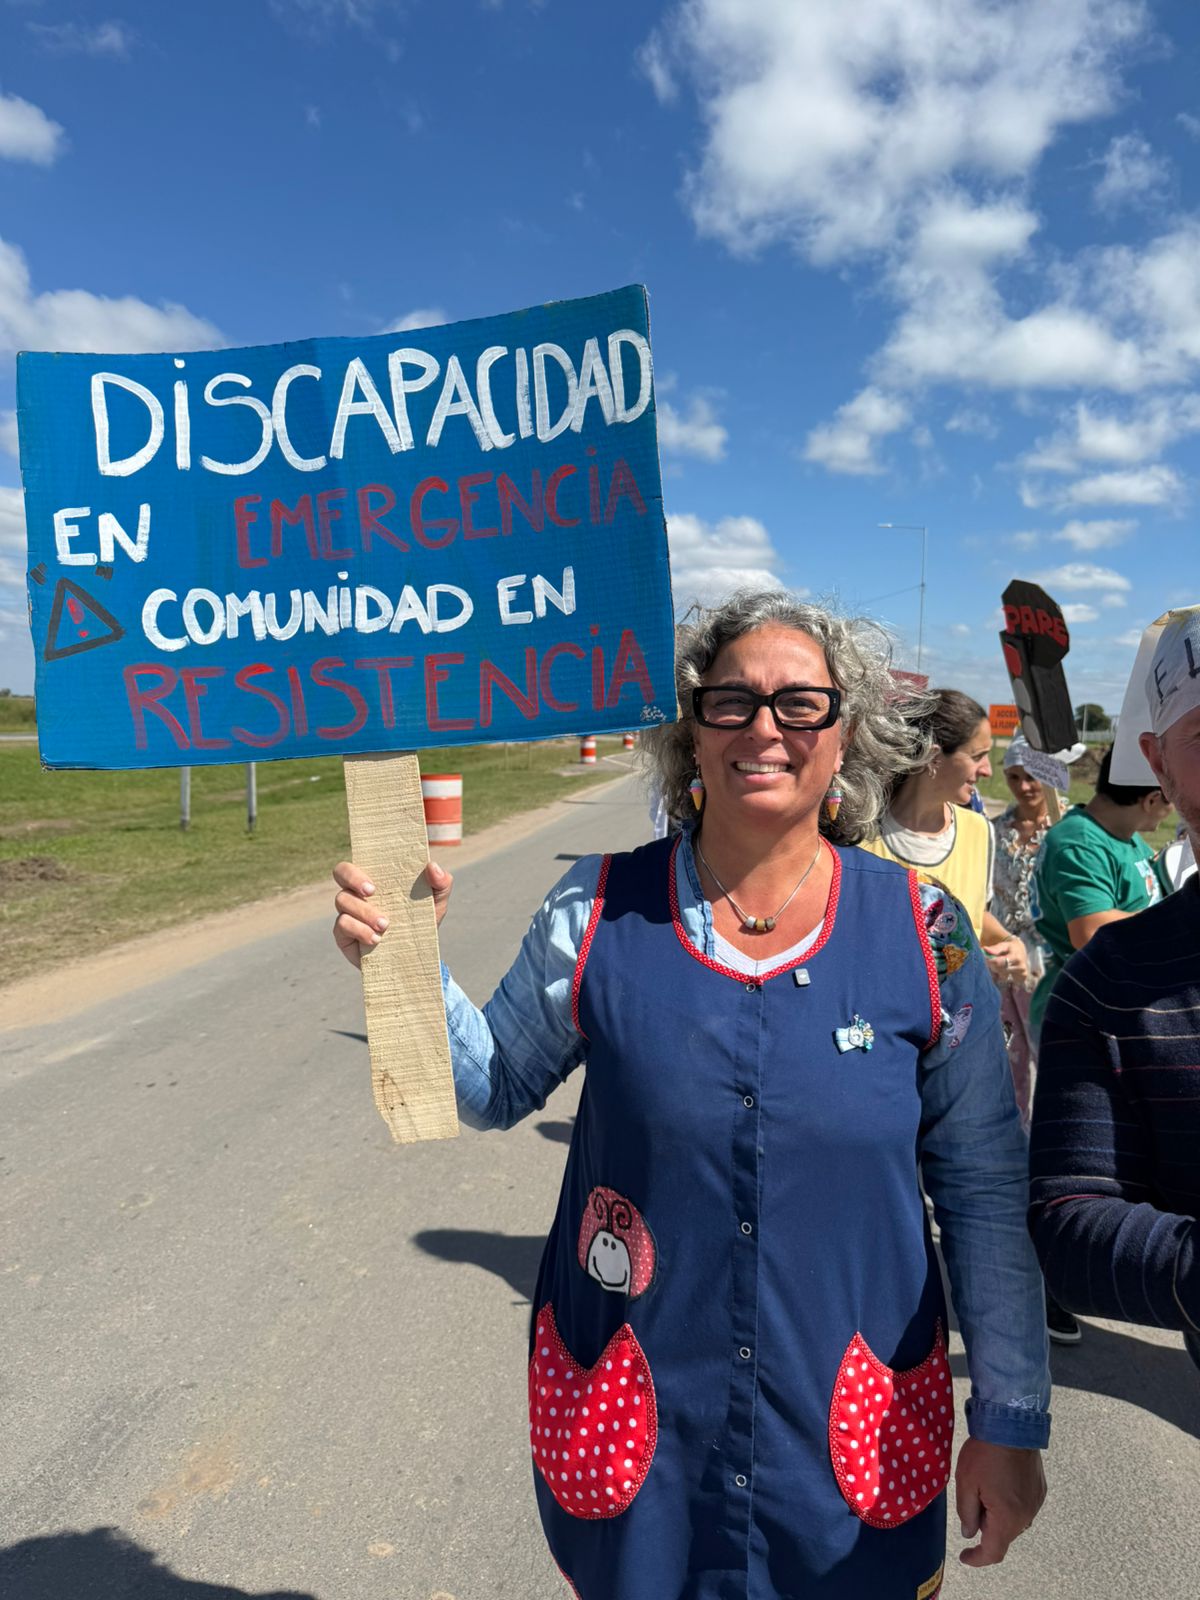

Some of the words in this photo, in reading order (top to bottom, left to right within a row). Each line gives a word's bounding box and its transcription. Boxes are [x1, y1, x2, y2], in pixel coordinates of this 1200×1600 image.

[53, 503, 151, 566] EN
[497, 565, 577, 625] EN
[1002, 604, 1068, 648] PARE
